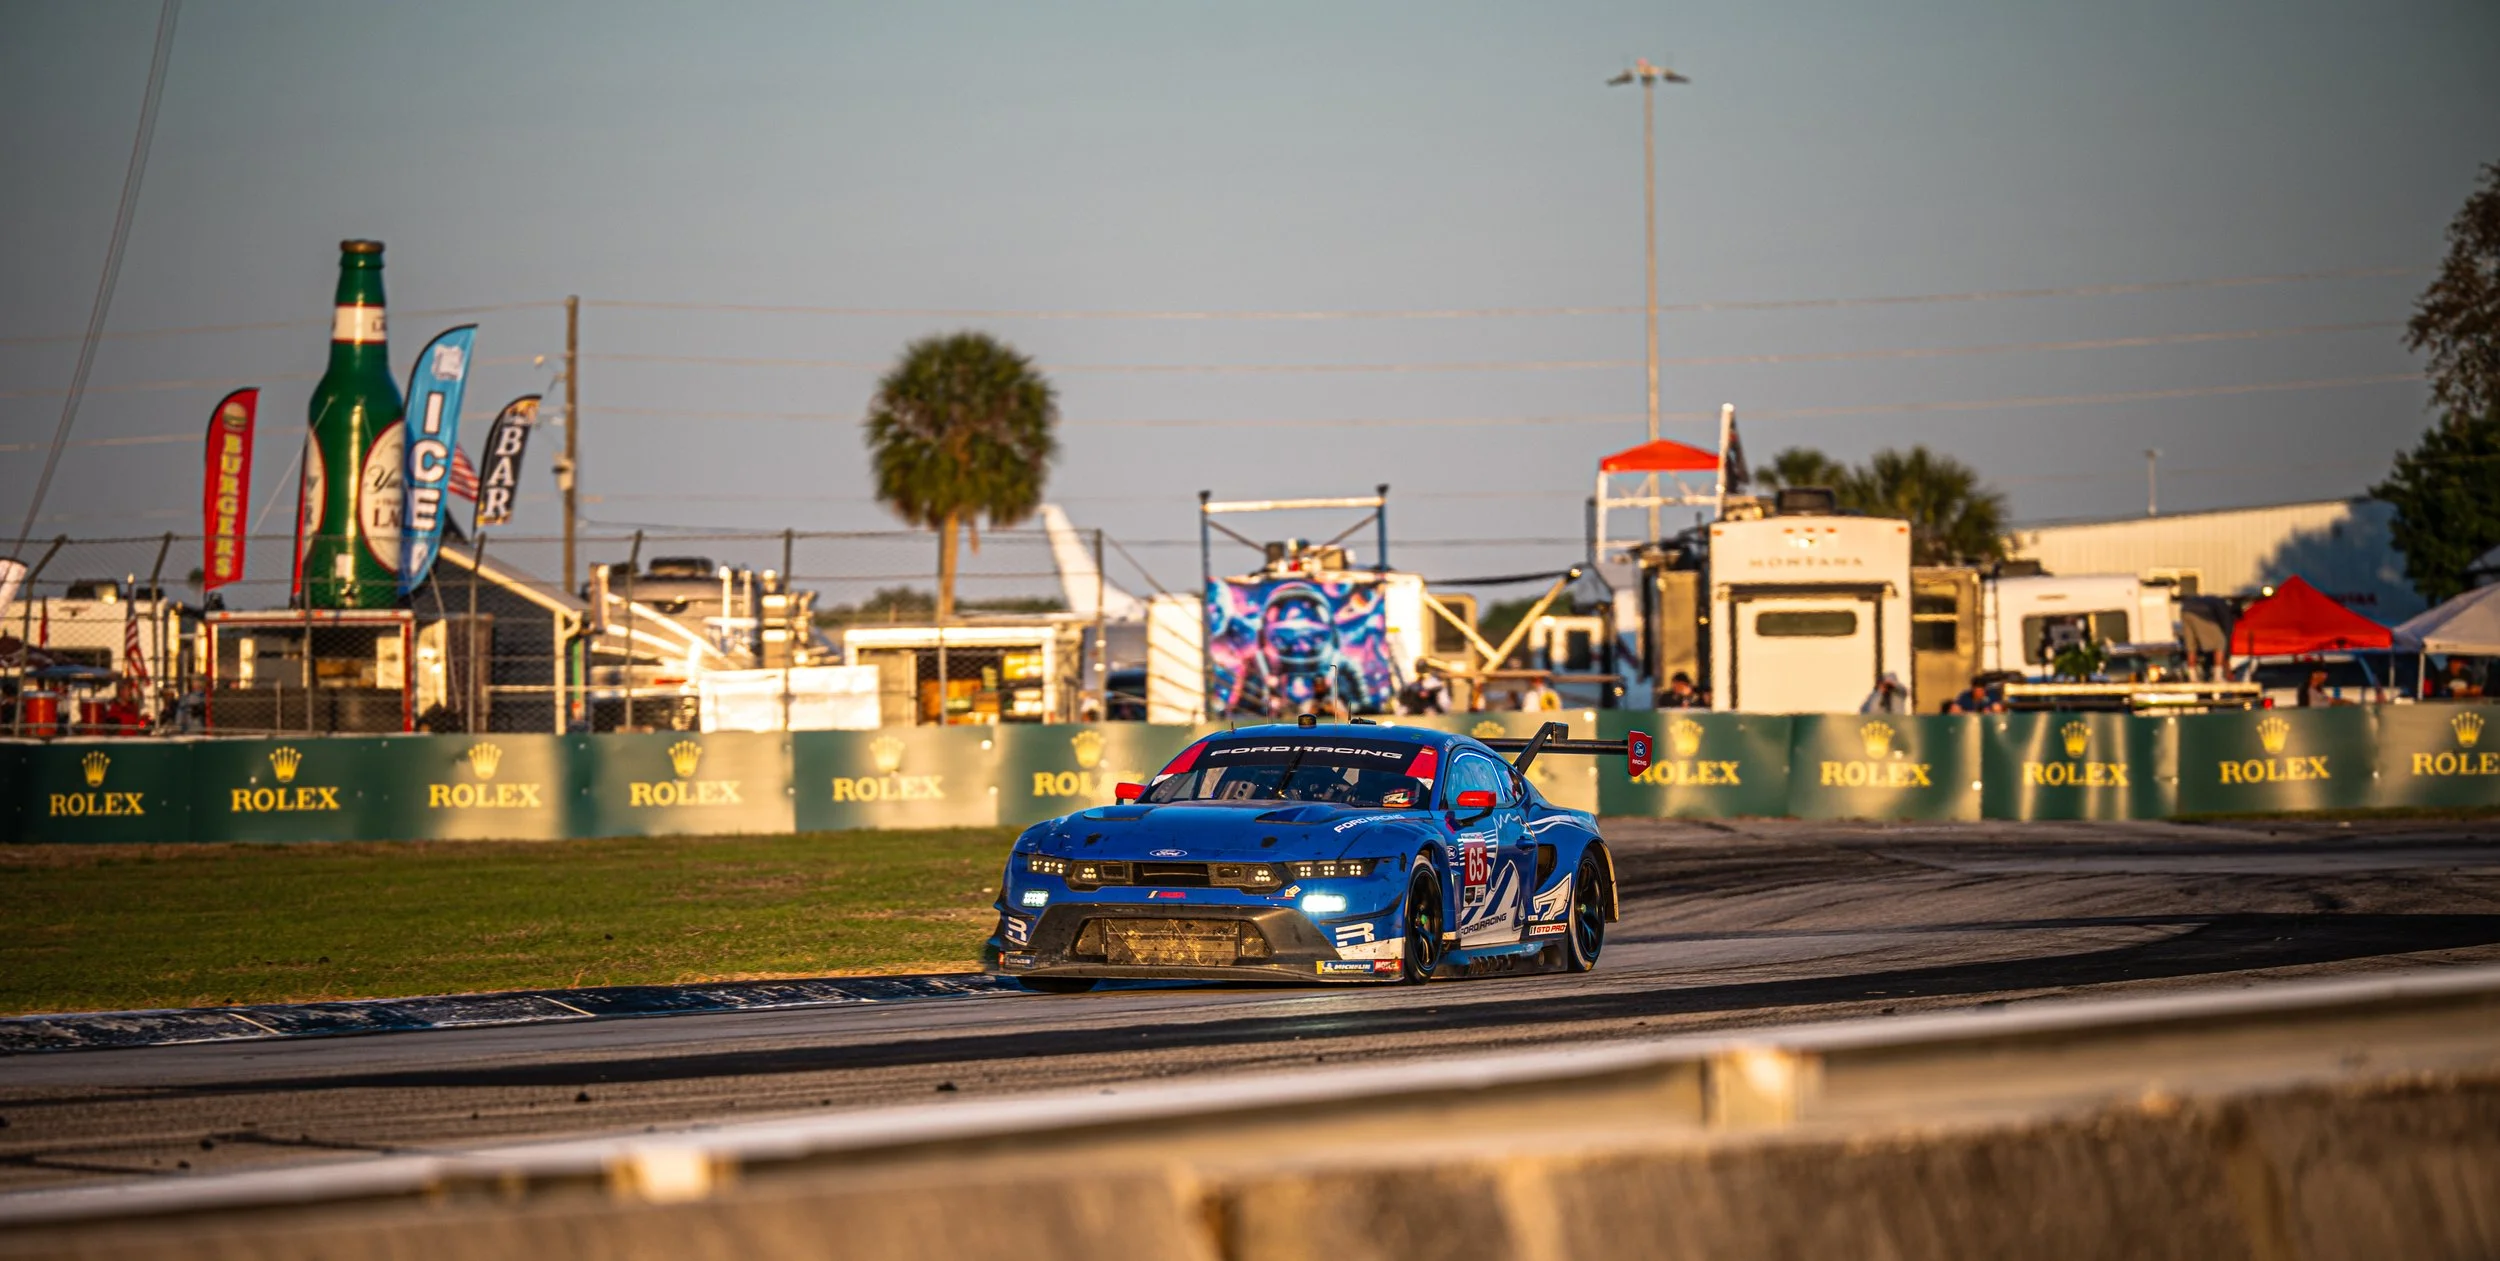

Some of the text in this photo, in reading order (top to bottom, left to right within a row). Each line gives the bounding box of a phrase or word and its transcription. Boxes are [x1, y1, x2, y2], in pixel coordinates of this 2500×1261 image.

[411, 391, 448, 531] ICE
[484, 427, 523, 518] BAR
[215, 433, 242, 577] BURGERS
[1211, 746, 1403, 760] FORD RACING
[1820, 761, 1932, 788] ROLEX
[2023, 761, 2129, 788] ROLEX
[2219, 756, 2332, 784] ROLEX
[231, 787, 341, 813] ROLEX
[428, 783, 542, 808] ROLEX
[629, 781, 744, 807] ROLEX
[832, 776, 945, 802] ROLEX
[49, 792, 146, 816] ROLEX
[1334, 818, 1368, 833] FORD
[1469, 847, 1484, 881] 65
[1461, 913, 1508, 936] FORD RACING
[1536, 924, 1566, 934] GTD PRO
[1334, 963, 1371, 971] MICHELIN
